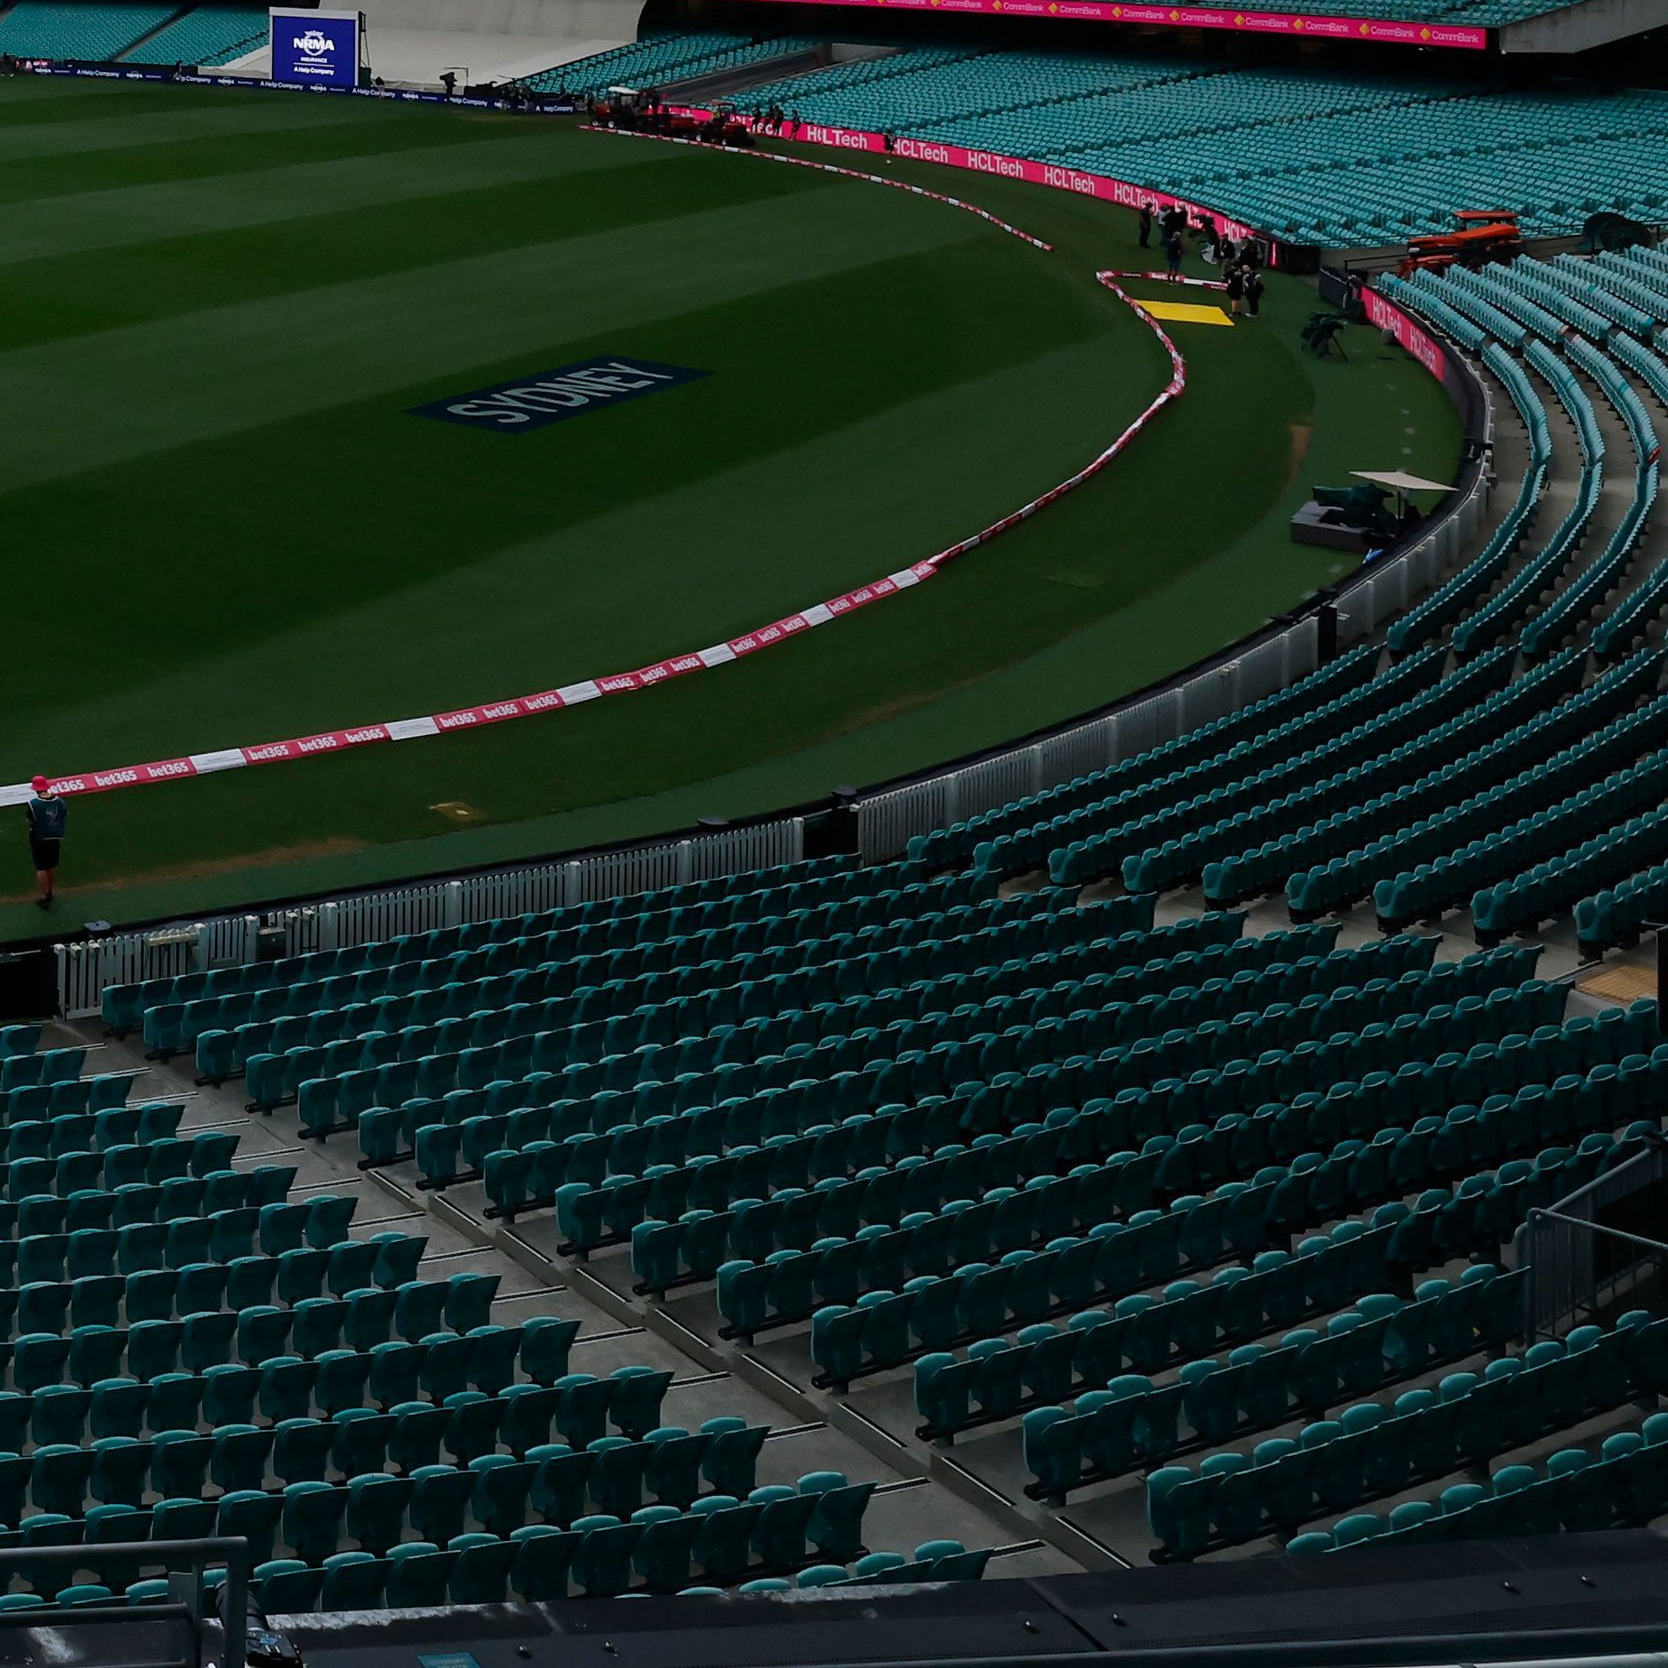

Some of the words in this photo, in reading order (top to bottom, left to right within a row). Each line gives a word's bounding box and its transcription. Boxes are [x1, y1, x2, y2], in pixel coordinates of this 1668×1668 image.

[941, 0, 982, 8] CommBank
[1060, 5, 1101, 15] CommBank
[1246, 17, 1288, 28] CommBank
[1371, 26, 1414, 37] CommBank
[1432, 31, 1479, 43] CommBank
[293, 38, 335, 51] NRMA
[968, 151, 1023, 178] HCLTech
[1045, 166, 1094, 195] HCLTech
[446, 362, 674, 423] SYDNEY
[669, 656, 700, 671] bet365
[639, 666, 667, 682] bet365
[600, 676, 634, 692] bet365
[524, 694, 559, 710] bet365
[440, 712, 477, 728] bet365
[297, 736, 337, 752] bet365
[247, 745, 289, 760] bet365
[147, 761, 189, 778] bet365
[94, 769, 138, 787] bet365
[47, 779, 85, 794] et365
